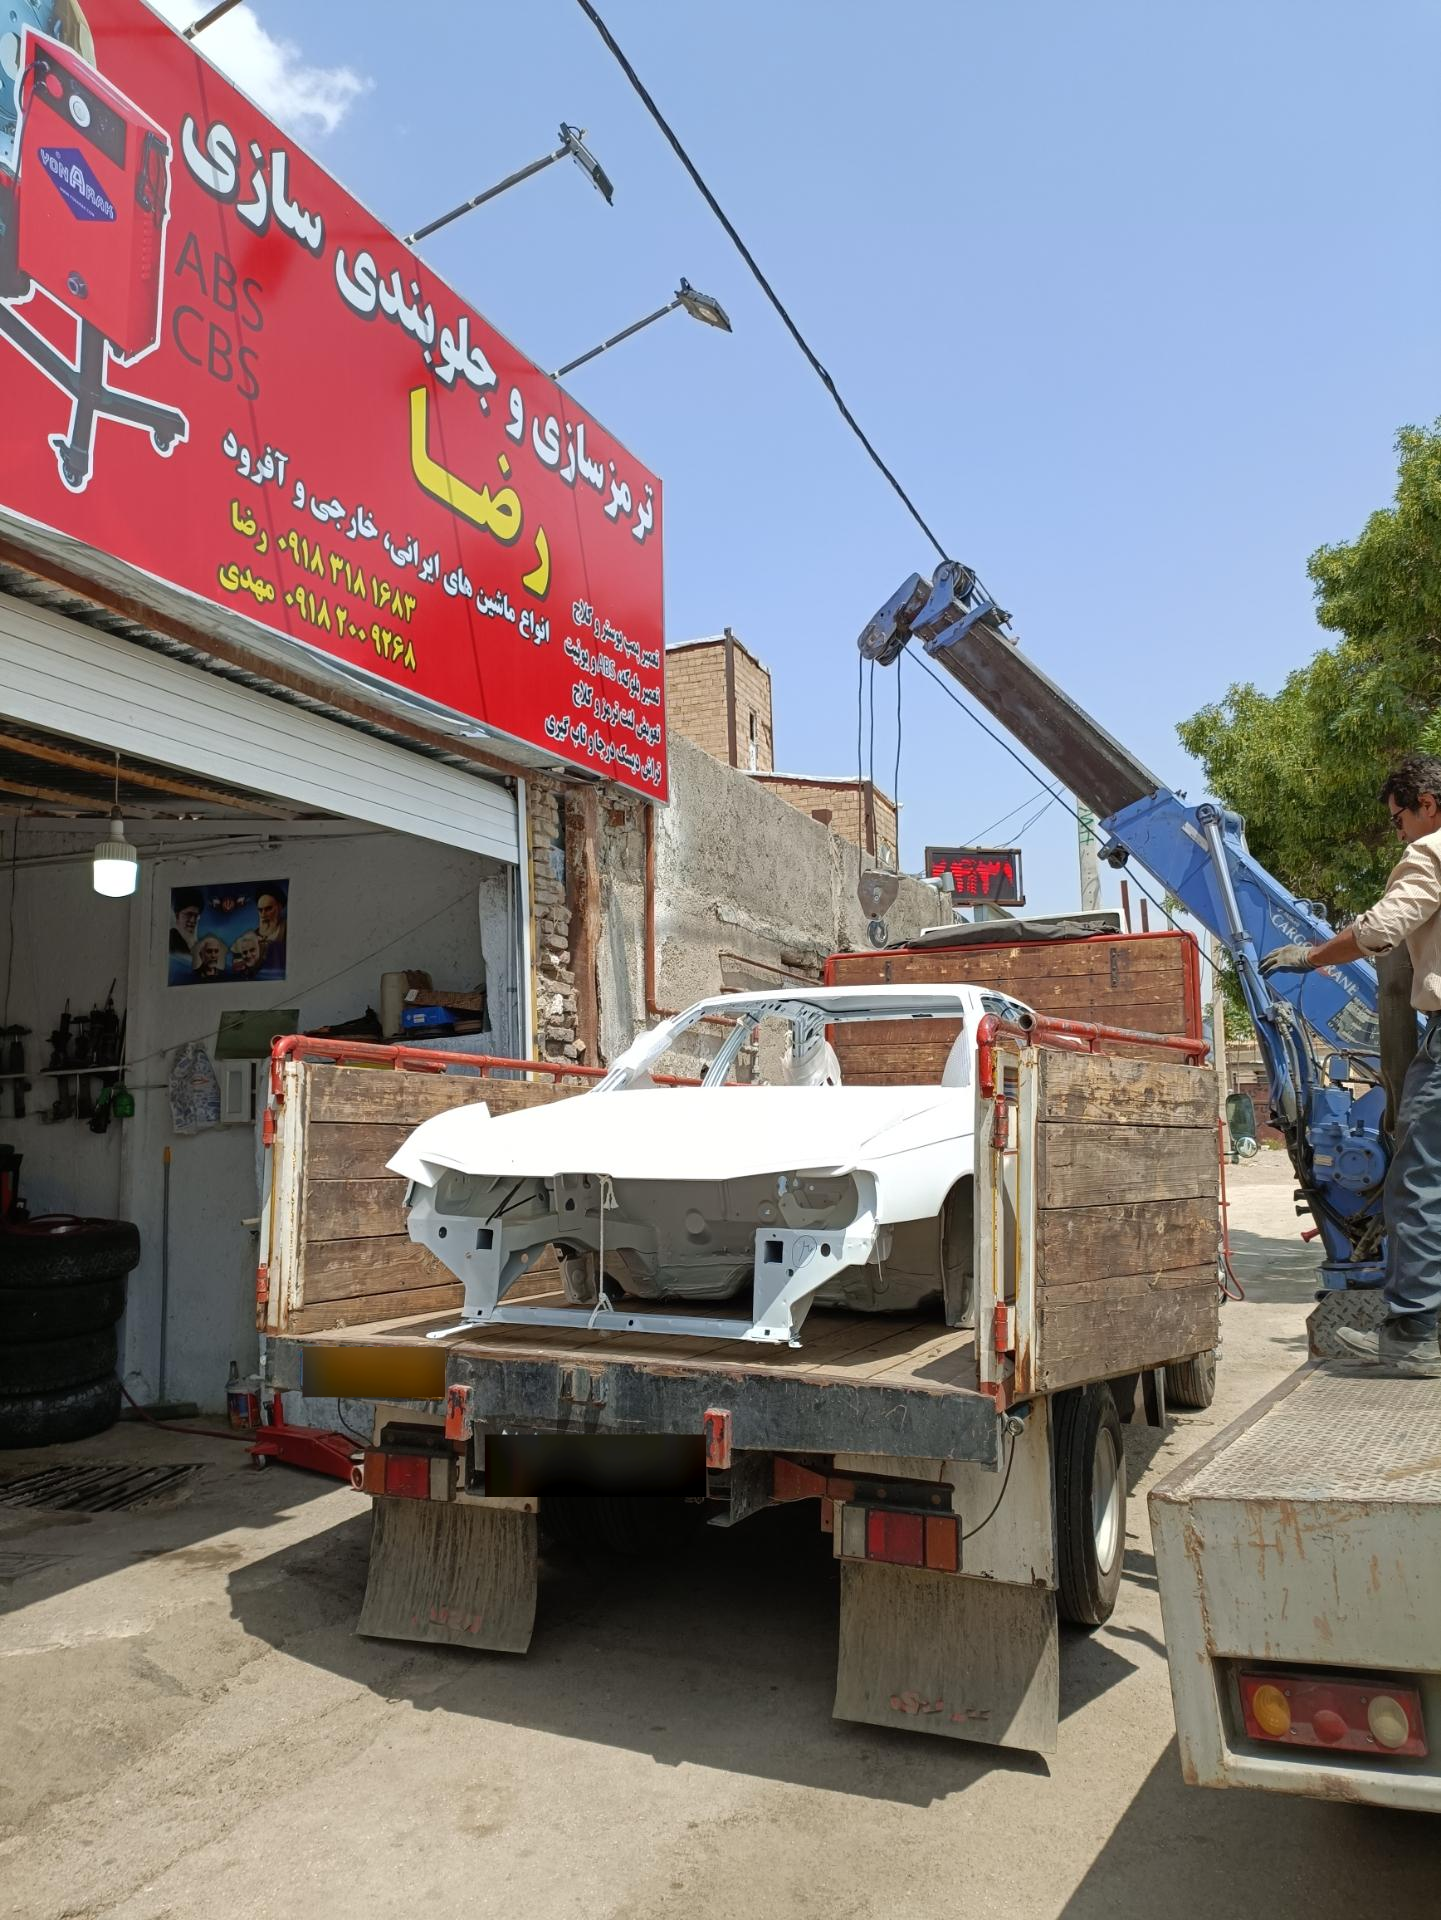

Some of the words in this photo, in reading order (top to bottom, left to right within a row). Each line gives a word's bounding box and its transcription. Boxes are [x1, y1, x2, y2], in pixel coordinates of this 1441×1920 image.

[181, 116, 323, 250] سازی
[175, 231, 264, 333] ABS
[334, 248, 498, 411] جلوبندی
[172, 305, 260, 401] CBS
[504, 386, 525, 441] و
[222, 431, 290, 487] آفرود
[292, 480, 306, 510] و
[409, 386, 551, 596] رضا
[231, 500, 269, 554] رضا
[309, 495, 380, 540] خارجی
[277, 530, 326, 578] ۰۹۱۸
[218, 564, 276, 603] مهدی
[328, 552, 367, 600] ۳۱۸
[442, 567, 474, 599] های
[284, 585, 332, 631] ۰۹۱۸
[371, 576, 417, 622] ۱۶۸۳
[475, 590, 517, 623] ماشین
[572, 598, 593, 626] کلاچ
[334, 607, 367, 641] ۲۰۰
[517, 609, 551, 646] انواع
[594, 618, 600, 638] و
[370, 623, 417, 671] ۹۲۶۸
[590, 656, 597, 676] و
[597, 653, 615, 681] ABS
[572, 680, 593, 708] کلاچ
[594, 698, 600, 718] و
[601, 698, 619, 726] ترمز
[588, 736, 594, 755] و
[636, 716, 660, 746] تعویض
